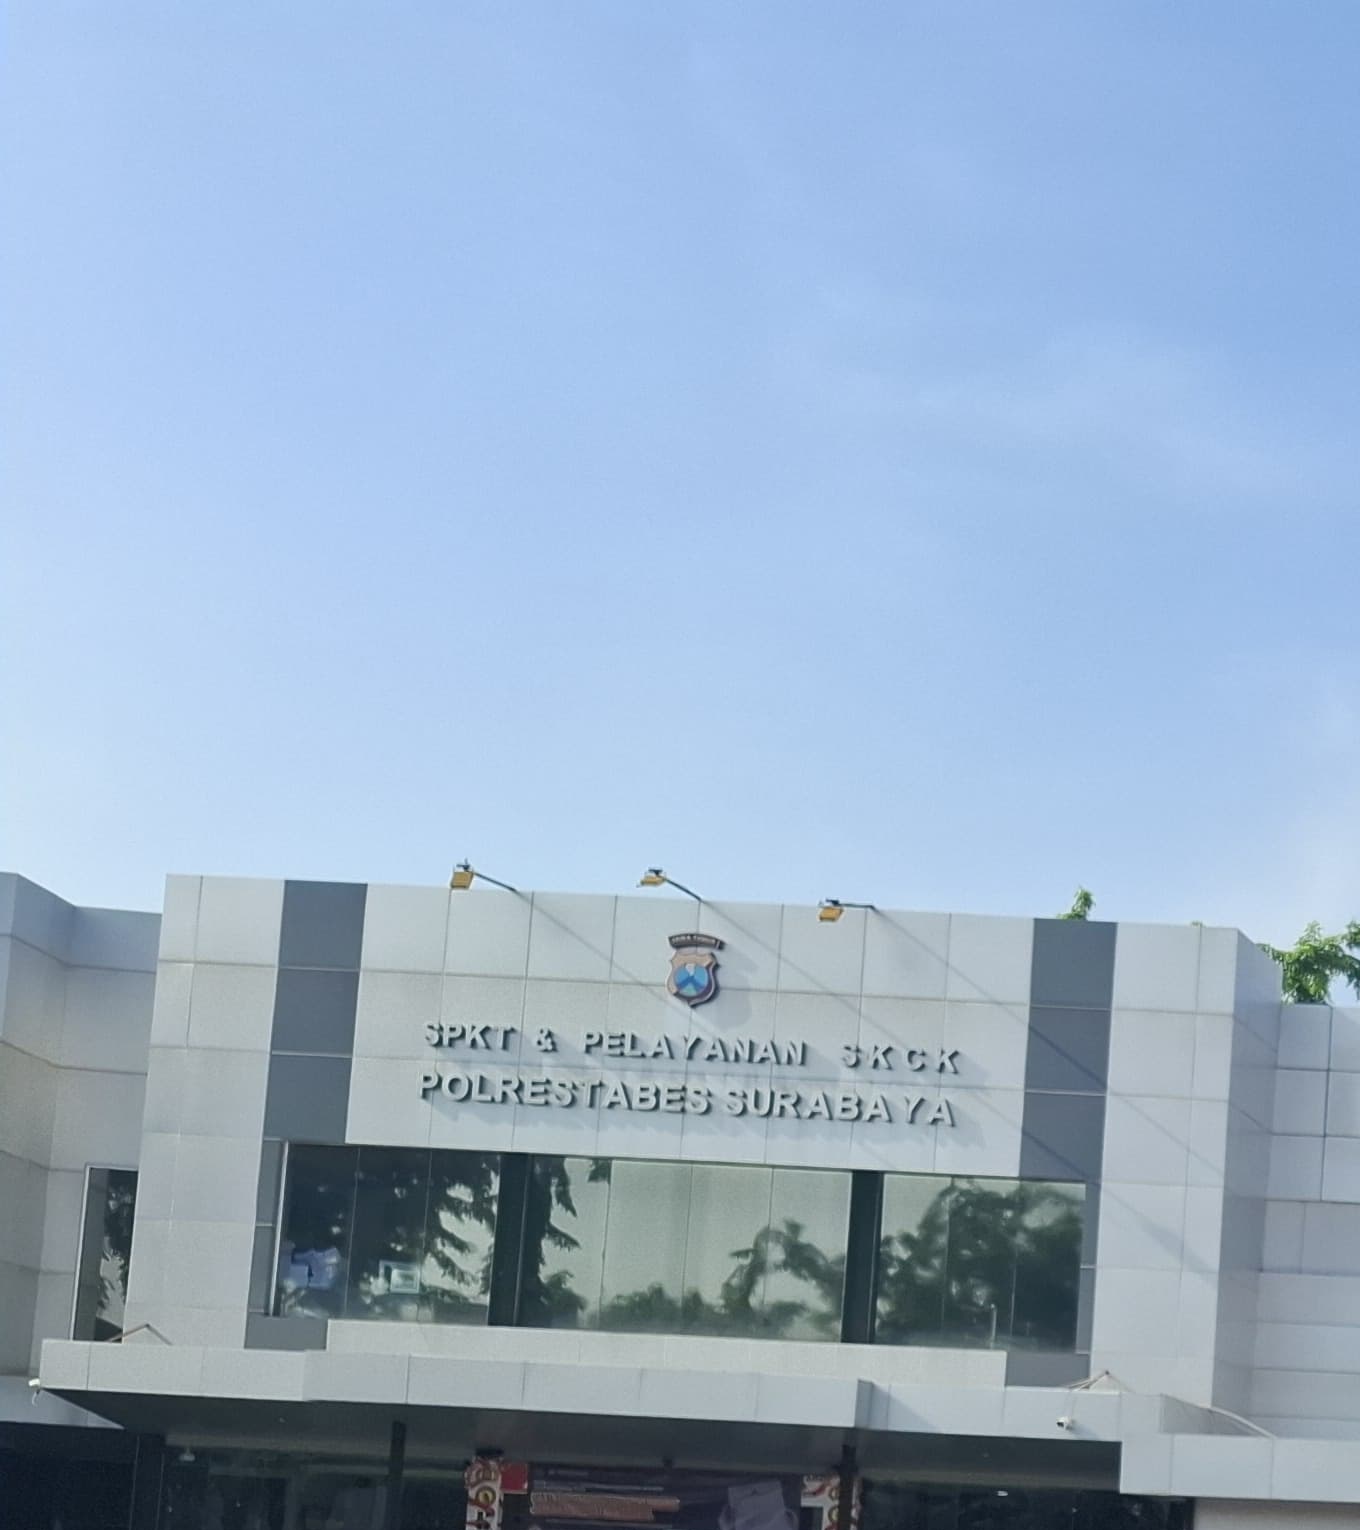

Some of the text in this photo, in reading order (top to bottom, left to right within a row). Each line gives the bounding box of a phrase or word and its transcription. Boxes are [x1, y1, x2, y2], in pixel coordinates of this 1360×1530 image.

[423, 1020, 962, 1076] SPKT & PELAYANAN SKCK
[419, 1069, 957, 1128] POLRESTABES SURABAYA
